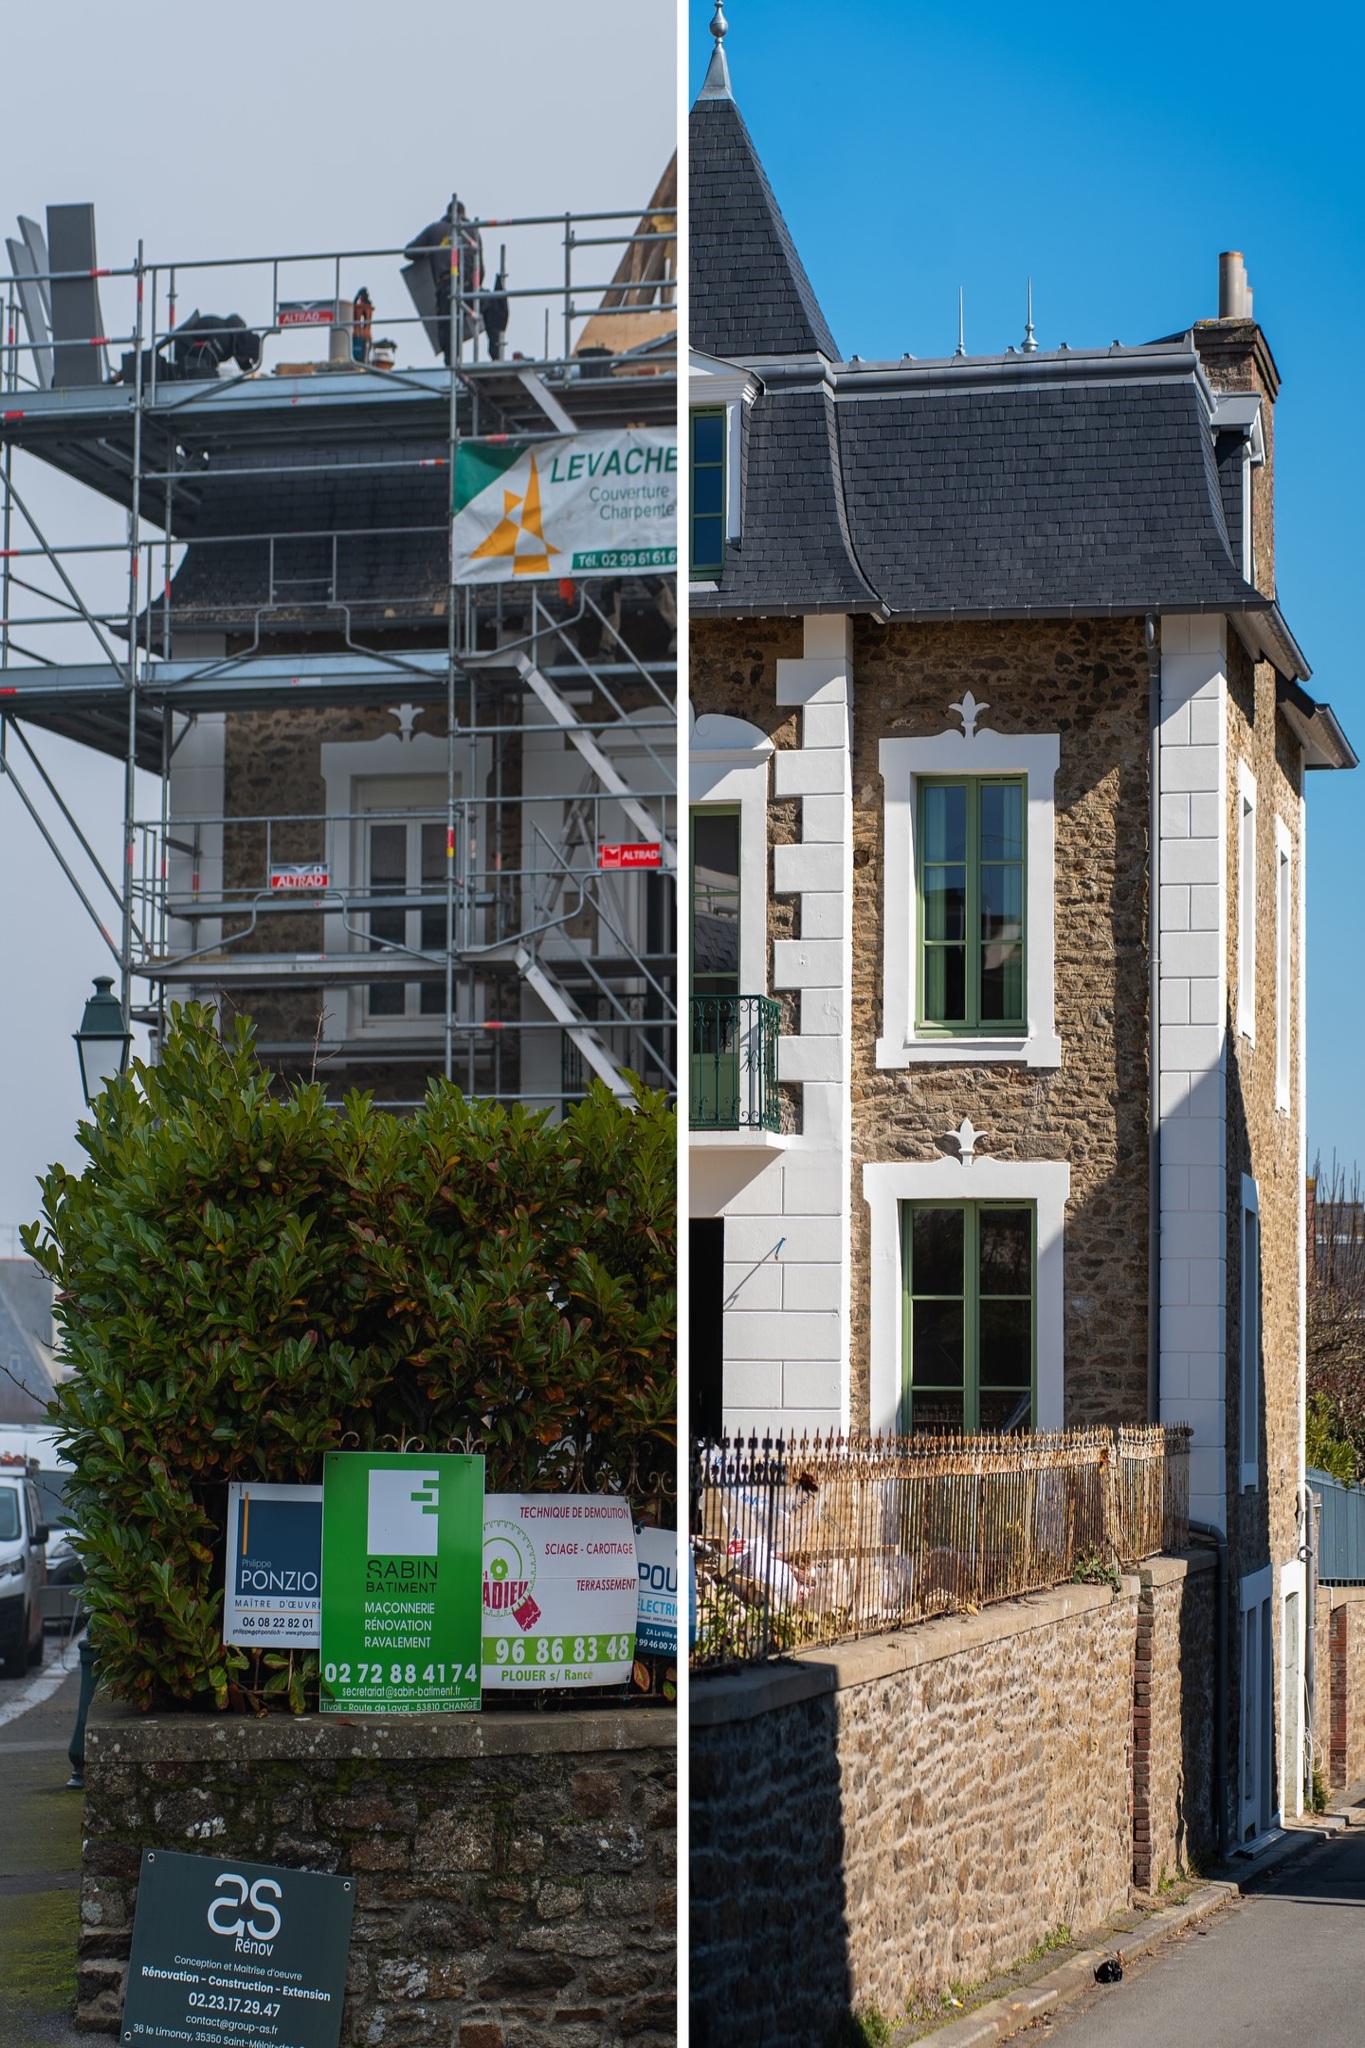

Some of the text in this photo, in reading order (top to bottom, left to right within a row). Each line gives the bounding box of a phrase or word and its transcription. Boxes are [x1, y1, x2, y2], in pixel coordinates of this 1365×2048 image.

[550, 446, 677, 483] LEVACHE
[589, 486, 669, 503] Couverture
[600, 504, 675, 520] Charpente
[602, 552, 617, 567] 02
[620, 552, 636, 566] 99
[638, 550, 650, 565] 61
[652, 550, 666, 564] 61
[668, 549, 677, 562] 6
[622, 849, 659, 860] ALTRAD
[277, 875, 323, 888] ALTRAD
[520, 1506, 629, 1519] TECHNIQUE DE DEMOLITION
[545, 1543, 578, 1555] SCIAGE
[586, 1543, 633, 1555] CAROTTAGE
[241, 1559, 272, 1569] Philippe
[366, 1560, 438, 1579] SABIN
[241, 1570, 318, 1591] PONZIO
[366, 1581, 437, 1593] BATIMENT
[577, 1579, 637, 1591] TERRASSEMENT
[365, 1602, 435, 1615] MAÇONNERIE
[637, 1598, 677, 1616] LECTRI
[242, 1617, 313, 1628] 06 08 22 82 01
[365, 1617, 432, 1631] RÉNOVATION
[646, 1628, 654, 1636] ZA
[364, 1636, 431, 1648] RAVALEMENT
[496, 1635, 630, 1664] 96 86 83 48
[639, 1638, 648, 1647] 99
[649, 1640, 658, 1649] 46
[658, 1641, 668, 1650] 00
[325, 1663, 477, 1684] 02 72 88 41 74
[501, 1669, 546, 1682] PLOUER
[349, 1703, 372, 1712] Route
[374, 1704, 386, 1712] de
[388, 1704, 410, 1712] Laval
[416, 1703, 440, 1711] 53810
[235, 1937, 274, 1957] Rénov
[174, 1955, 222, 1970] Conception
[224, 1963, 232, 1972] et
[142, 1966, 200, 1984] Rénovation
[208, 1975, 274, 1994] Construction
[282, 1985, 331, 2002] Extension
[188, 1992, 281, 2018] 02.23.17.29.47
[186, 2014, 278, 2035] contact@group-as.fr
[133, 2023, 144, 2034] 36
[146, 2024, 154, 2035] le
[155, 2026, 194, 2042] Limonay,
[195, 2032, 222, 2044] 35350
